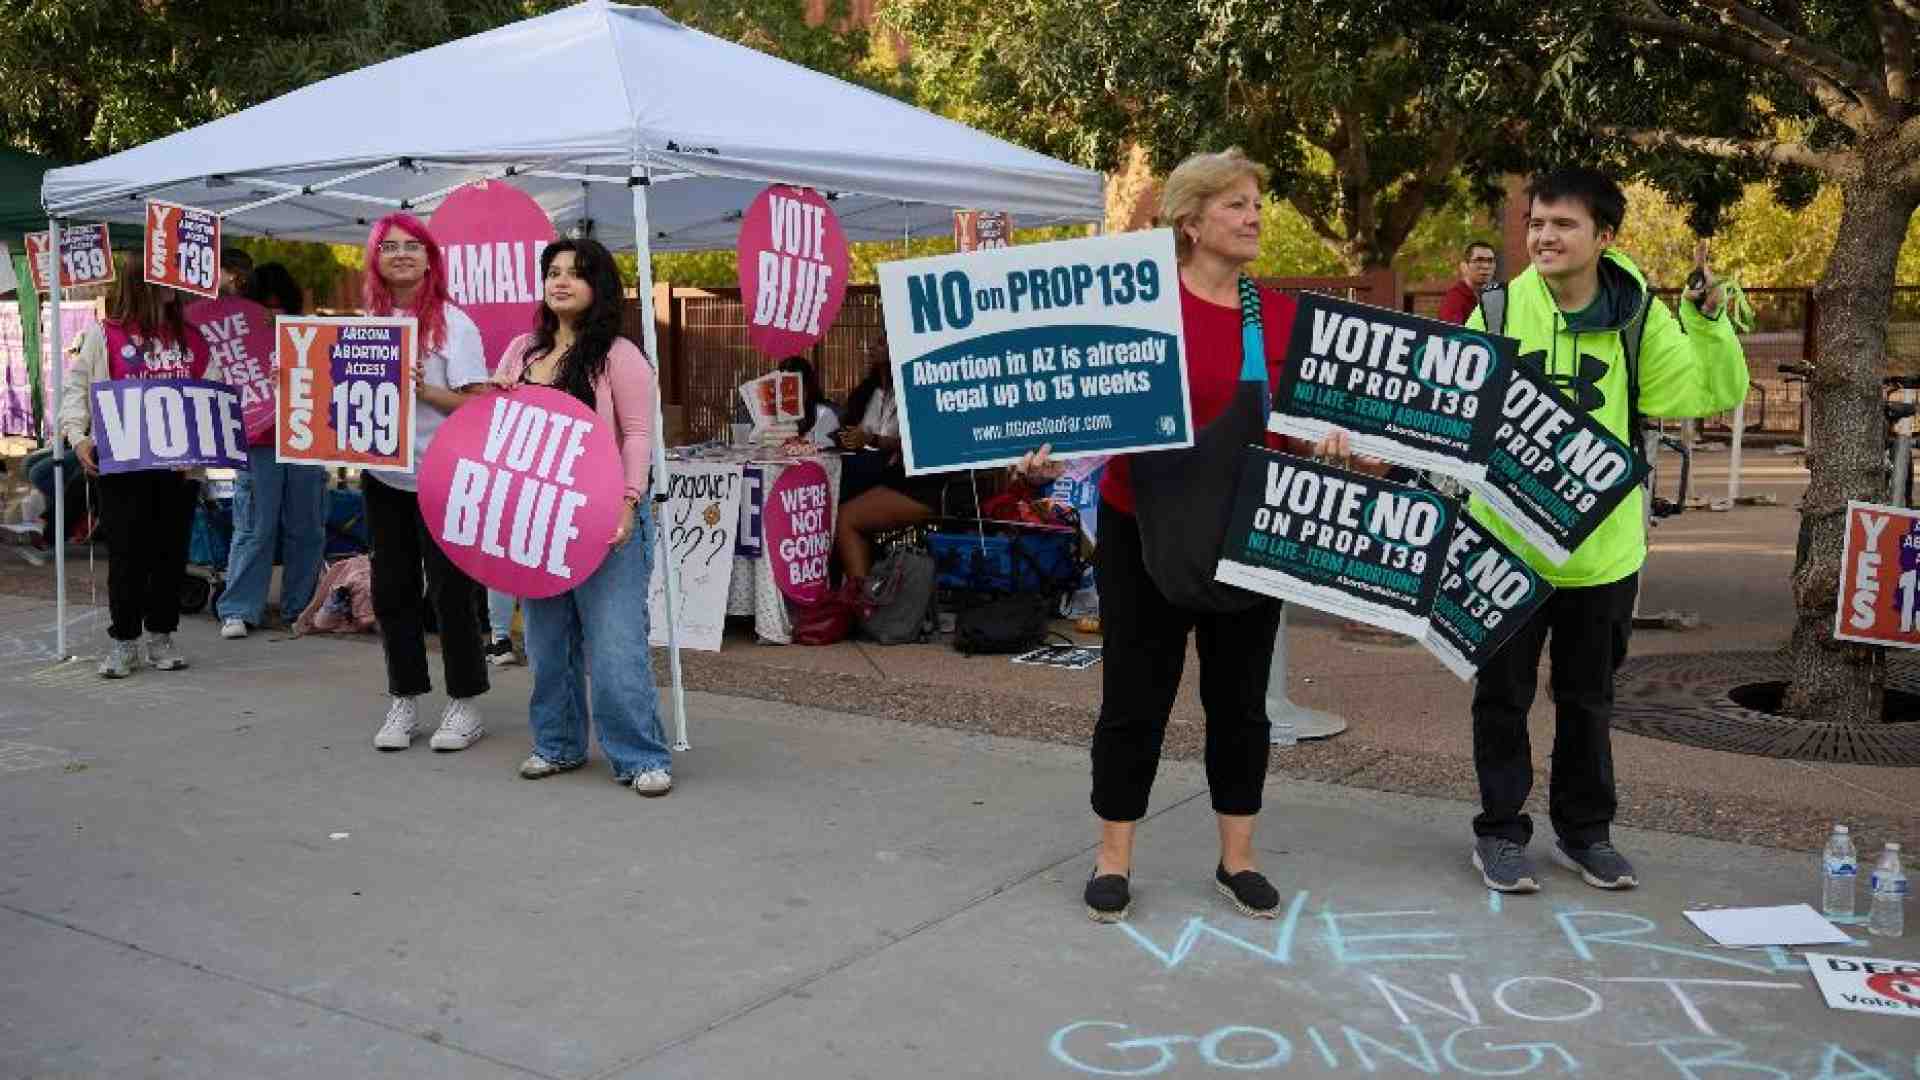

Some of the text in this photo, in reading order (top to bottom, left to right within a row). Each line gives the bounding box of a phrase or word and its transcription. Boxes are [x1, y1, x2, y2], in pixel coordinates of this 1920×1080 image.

[152, 205, 168, 279] YES
[769, 194, 826, 262] VOTE
[63, 248, 108, 281] 139
[178, 242, 215, 289] 139
[753, 251, 833, 336] BLUE
[907, 259, 1160, 334] NO on PROP 139
[201, 312, 249, 343] AVE
[333, 344, 400, 361] ABORTION
[342, 328, 390, 341] ARIZONA
[1310, 307, 1491, 392] VOTE NO
[287, 326, 317, 451] YES
[345, 361, 386, 377] ACCESS
[912, 336, 1168, 386] Abortion in AZ is already
[936, 369, 1151, 413] legal up to 15 weeks
[1299, 357, 1480, 419] ON PROP 139
[96, 386, 248, 462] VOTE
[332, 380, 400, 456] 139
[482, 397, 593, 488] VOTE
[1294, 381, 1314, 402] NO
[1315, 385, 1394, 421] LATE-TERM
[1394, 405, 1473, 441] ABORTIONS
[1501, 369, 1627, 492] OTE NO
[780, 483, 827, 513] WE'RE
[1495, 423, 1555, 475] PROP
[1552, 474, 1598, 513] 139
[442, 457, 588, 580] BLUE
[791, 509, 823, 536] NOT
[1264, 461, 1368, 528] VOTE
[1367, 490, 1439, 547] NO
[1519, 475, 1580, 530] ABORTIONS
[1248, 531, 1268, 551] NO
[1268, 537, 1344, 573] LATE-TERM
[1344, 559, 1422, 595] ABORTIONS
[1253, 507, 1428, 575] ON PROP 139
[1850, 512, 1890, 630] YES
[1465, 546, 1531, 610] NO
[1898, 569, 1920, 632] 1
[1462, 591, 1504, 630] 139
[1363, 972, 1803, 1037] NOT
[1840, 991, 1899, 1011] Vote
[1047, 1018, 1920, 1080] GOING BA
